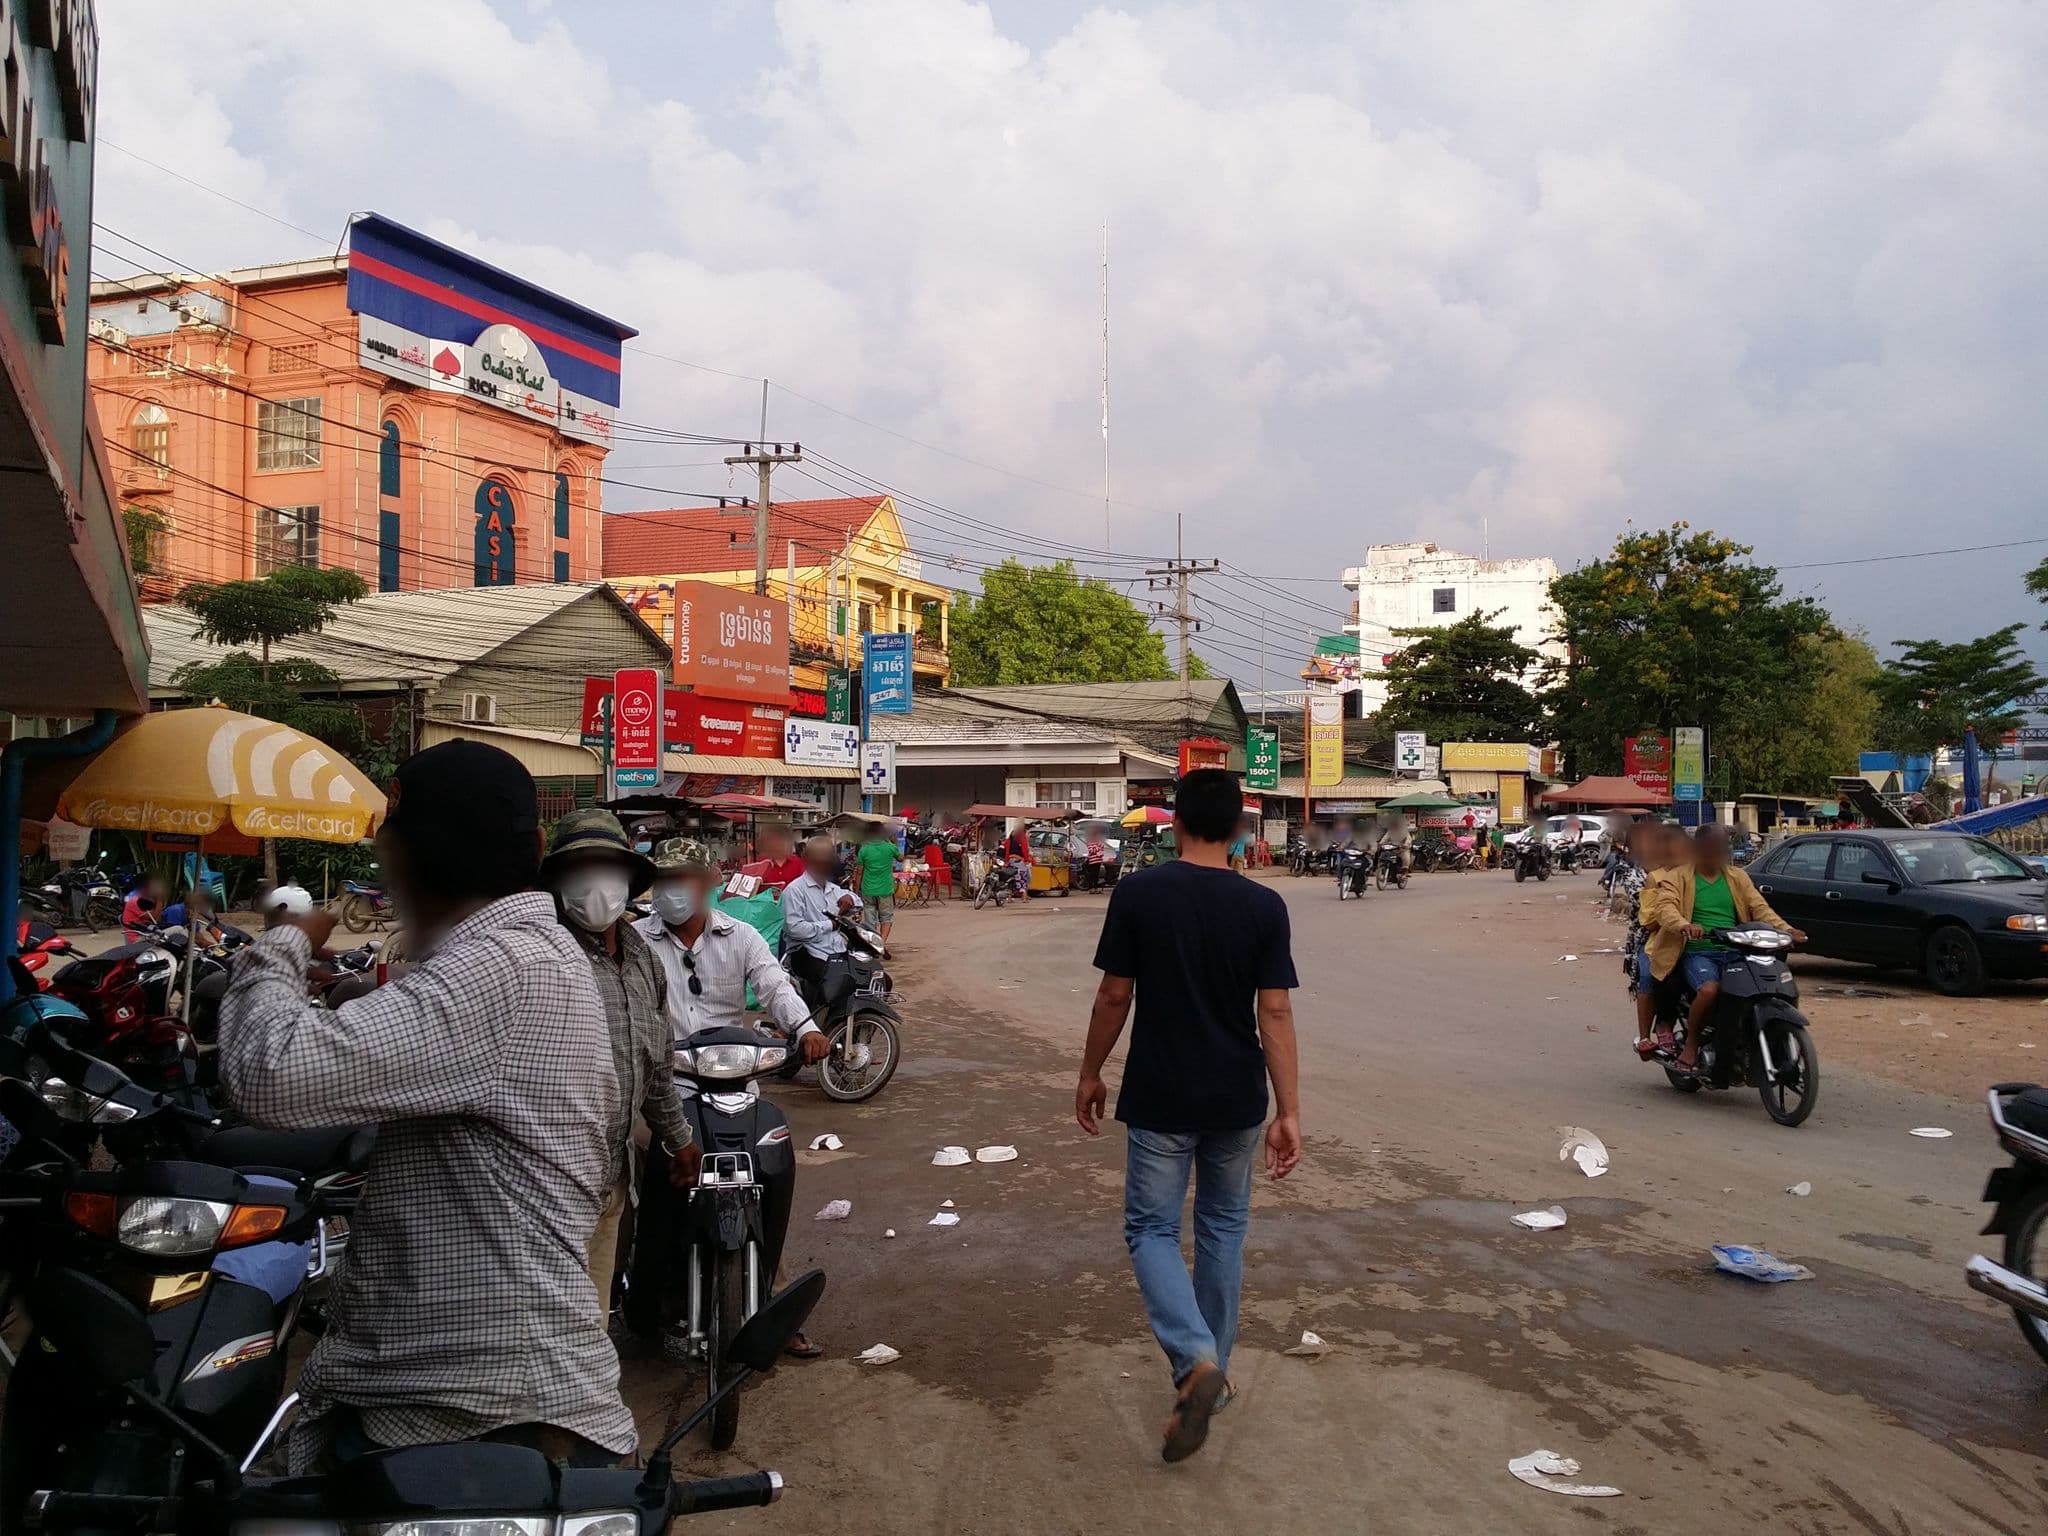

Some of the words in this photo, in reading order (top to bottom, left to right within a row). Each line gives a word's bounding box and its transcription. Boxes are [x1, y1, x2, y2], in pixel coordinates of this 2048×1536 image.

[481, 353, 514, 381] Orchid
[516, 366, 545, 391] Hotel
[468, 376, 497, 399] RICH
[524, 393, 555, 418] Casino
[487, 486, 503, 582] CASI
[680, 599, 693, 665] truemoney
[875, 690, 891, 700] 24/7
[617, 771, 655, 781] metfone
[1249, 767, 1269, 775] 1500
[108, 800, 213, 828] cellcard
[267, 809, 355, 837] cellcard
